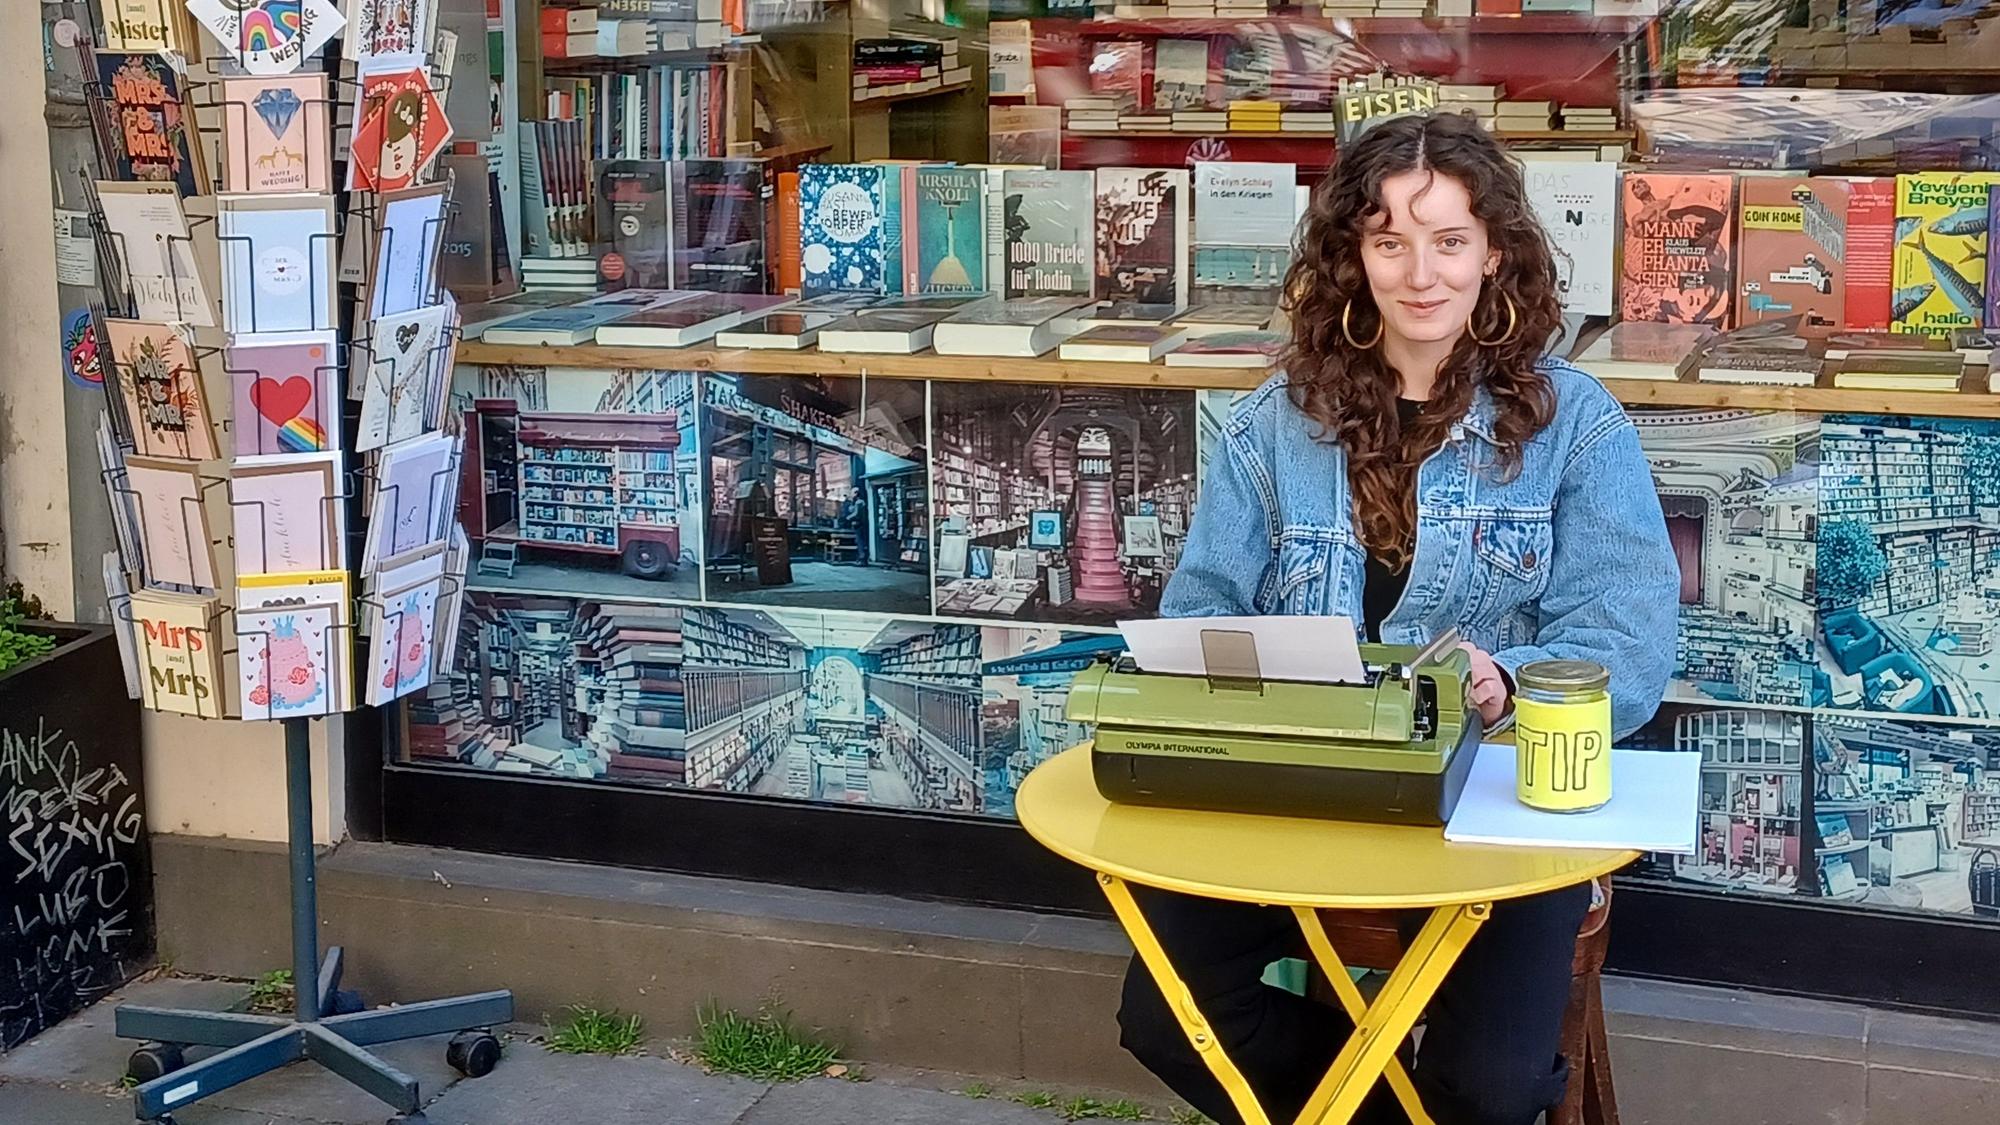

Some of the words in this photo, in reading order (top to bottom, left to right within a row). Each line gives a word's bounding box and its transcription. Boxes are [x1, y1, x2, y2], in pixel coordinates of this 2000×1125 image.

[110, 19, 168, 40] Mister
[115, 80, 165, 105] MRS
[1347, 87, 1435, 121] EISEN
[919, 175, 978, 188] URSULA
[1138, 179, 1168, 196] DIE
[1210, 178, 1239, 188] Evelyn
[1242, 178, 1273, 188] Schlag
[1220, 190, 1236, 198] den
[1238, 190, 1273, 199] Kriegen
[1744, 211, 1771, 222] GOIN
[1772, 212, 1801, 223] HOME
[1011, 241, 1040, 263] 1000
[1044, 241, 1085, 264] Briefe
[1643, 239, 1664, 254] ER
[1643, 256, 1710, 272] PHANTA
[1011, 268, 1031, 290] für
[1035, 268, 1073, 290] Rodin
[1641, 271, 1679, 288] SIEN
[1923, 311, 1971, 325] hallo
[136, 356, 170, 379] MR
[150, 404, 183, 425] MR
[142, 618, 203, 652] Mrs
[150, 665, 209, 699] Mrs
[1125, 741, 1162, 751] OLYMPIA
[1163, 743, 1230, 756] INTERNATIONAL
[1519, 722, 1602, 792] TIP
